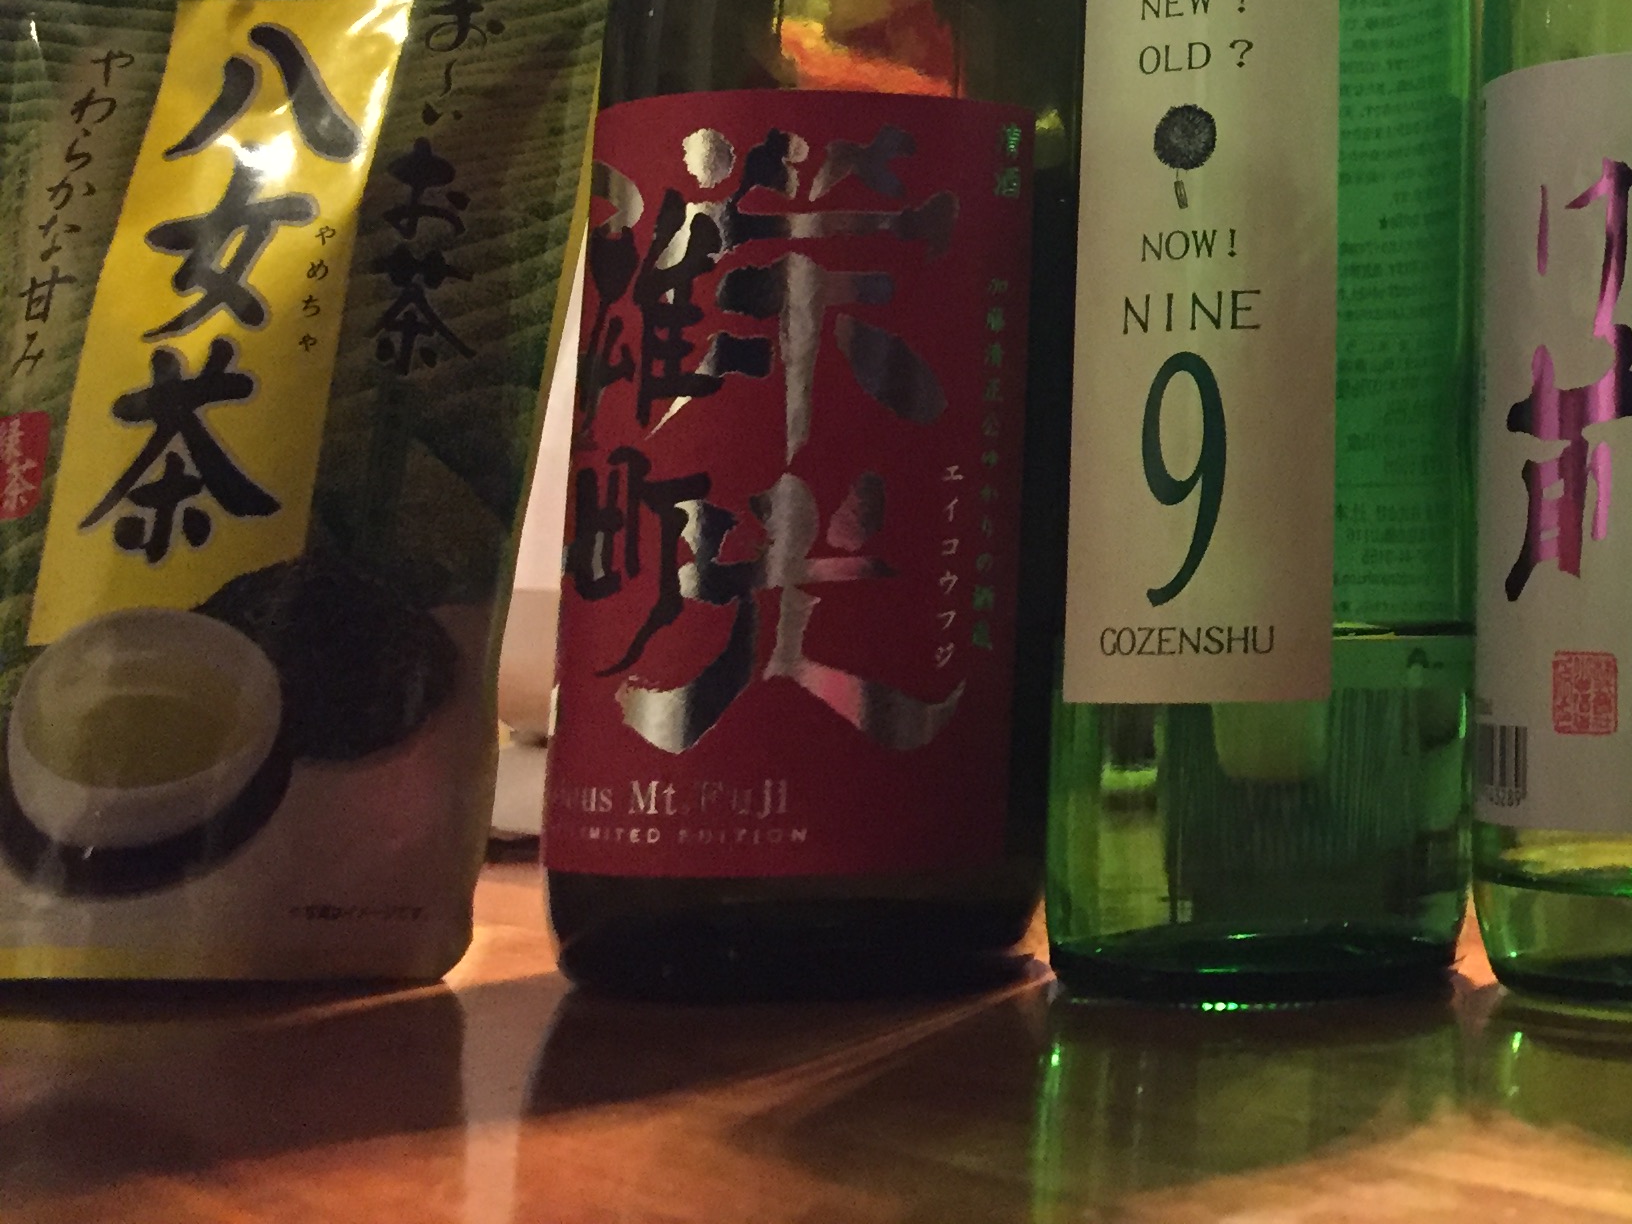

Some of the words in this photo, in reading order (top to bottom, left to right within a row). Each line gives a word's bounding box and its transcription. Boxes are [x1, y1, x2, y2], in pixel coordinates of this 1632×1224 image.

[1139, 43, 1212, 75] OLD
[1230, 40, 1254, 68] ?
[11, 49, 135, 373] やわらかな甘み
[78, 23, 364, 565] 八女茶
[1122, 290, 1262, 336] NINE
[933, 464, 965, 671] エイコウフジ
[1141, 352, 1227, 607] 9
[1100, 626, 1276, 657] GOZENSHU
